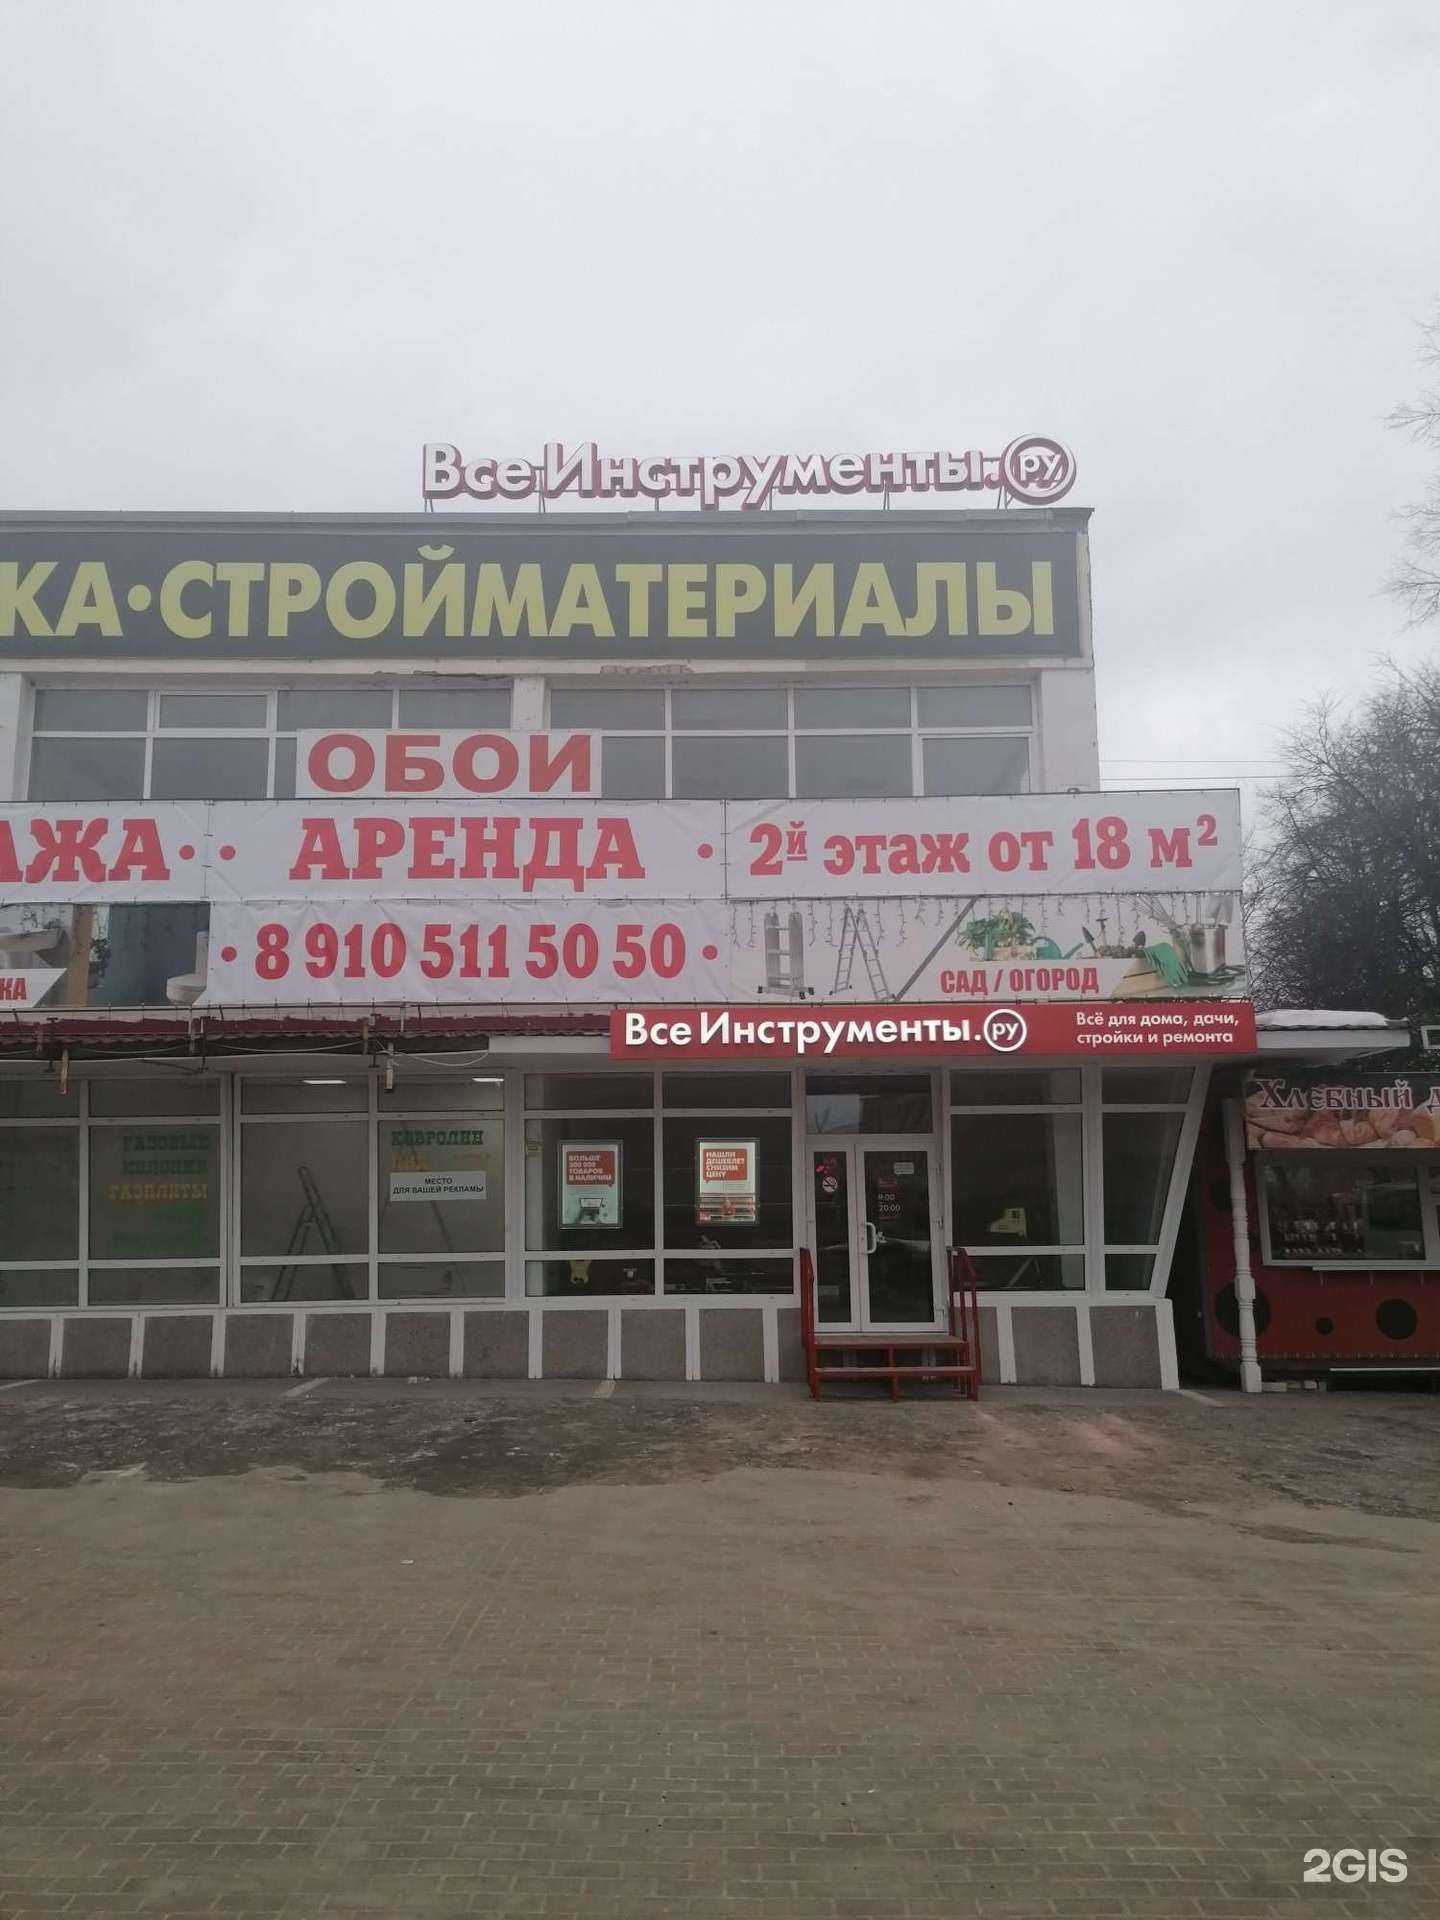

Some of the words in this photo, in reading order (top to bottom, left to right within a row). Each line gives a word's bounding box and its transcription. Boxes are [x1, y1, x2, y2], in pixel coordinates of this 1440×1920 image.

[159, 544, 1053, 639] СТРОЙМАТЕРИАЛЫ
[307, 733, 591, 793] ОБОИ
[289, 817, 646, 893] АРЕНДА
[823, 832, 970, 875] этаж
[988, 829, 1054, 872] от
[1071, 816, 1129, 870] 18
[255, 922, 290, 981] 8
[304, 922, 407, 980] 910
[420, 923, 510, 979] 511
[525, 922, 599, 980] 50
[612, 922, 686, 979] 50
[940, 970, 988, 996] САД
[1009, 967, 1099, 994] ОГОРОД
[1076, 1012, 1104, 1026] Всё
[1108, 1014, 1136, 1027] для
[1140, 1014, 1188, 1026] дома,
[1193, 1013, 1239, 1026] дачи,
[1077, 1031, 1143, 1048] стройки
[1148, 1032, 1158, 1043] и
[1163, 1032, 1233, 1047] ремонта
[393, 1186, 410, 1195] ДЛЯ
[412, 1185, 442, 1194] ВАШЕЙ
[443, 1184, 484, 1193] РЕКЛАМЫ
[424, 1177, 453, 1186] МЕСТО
